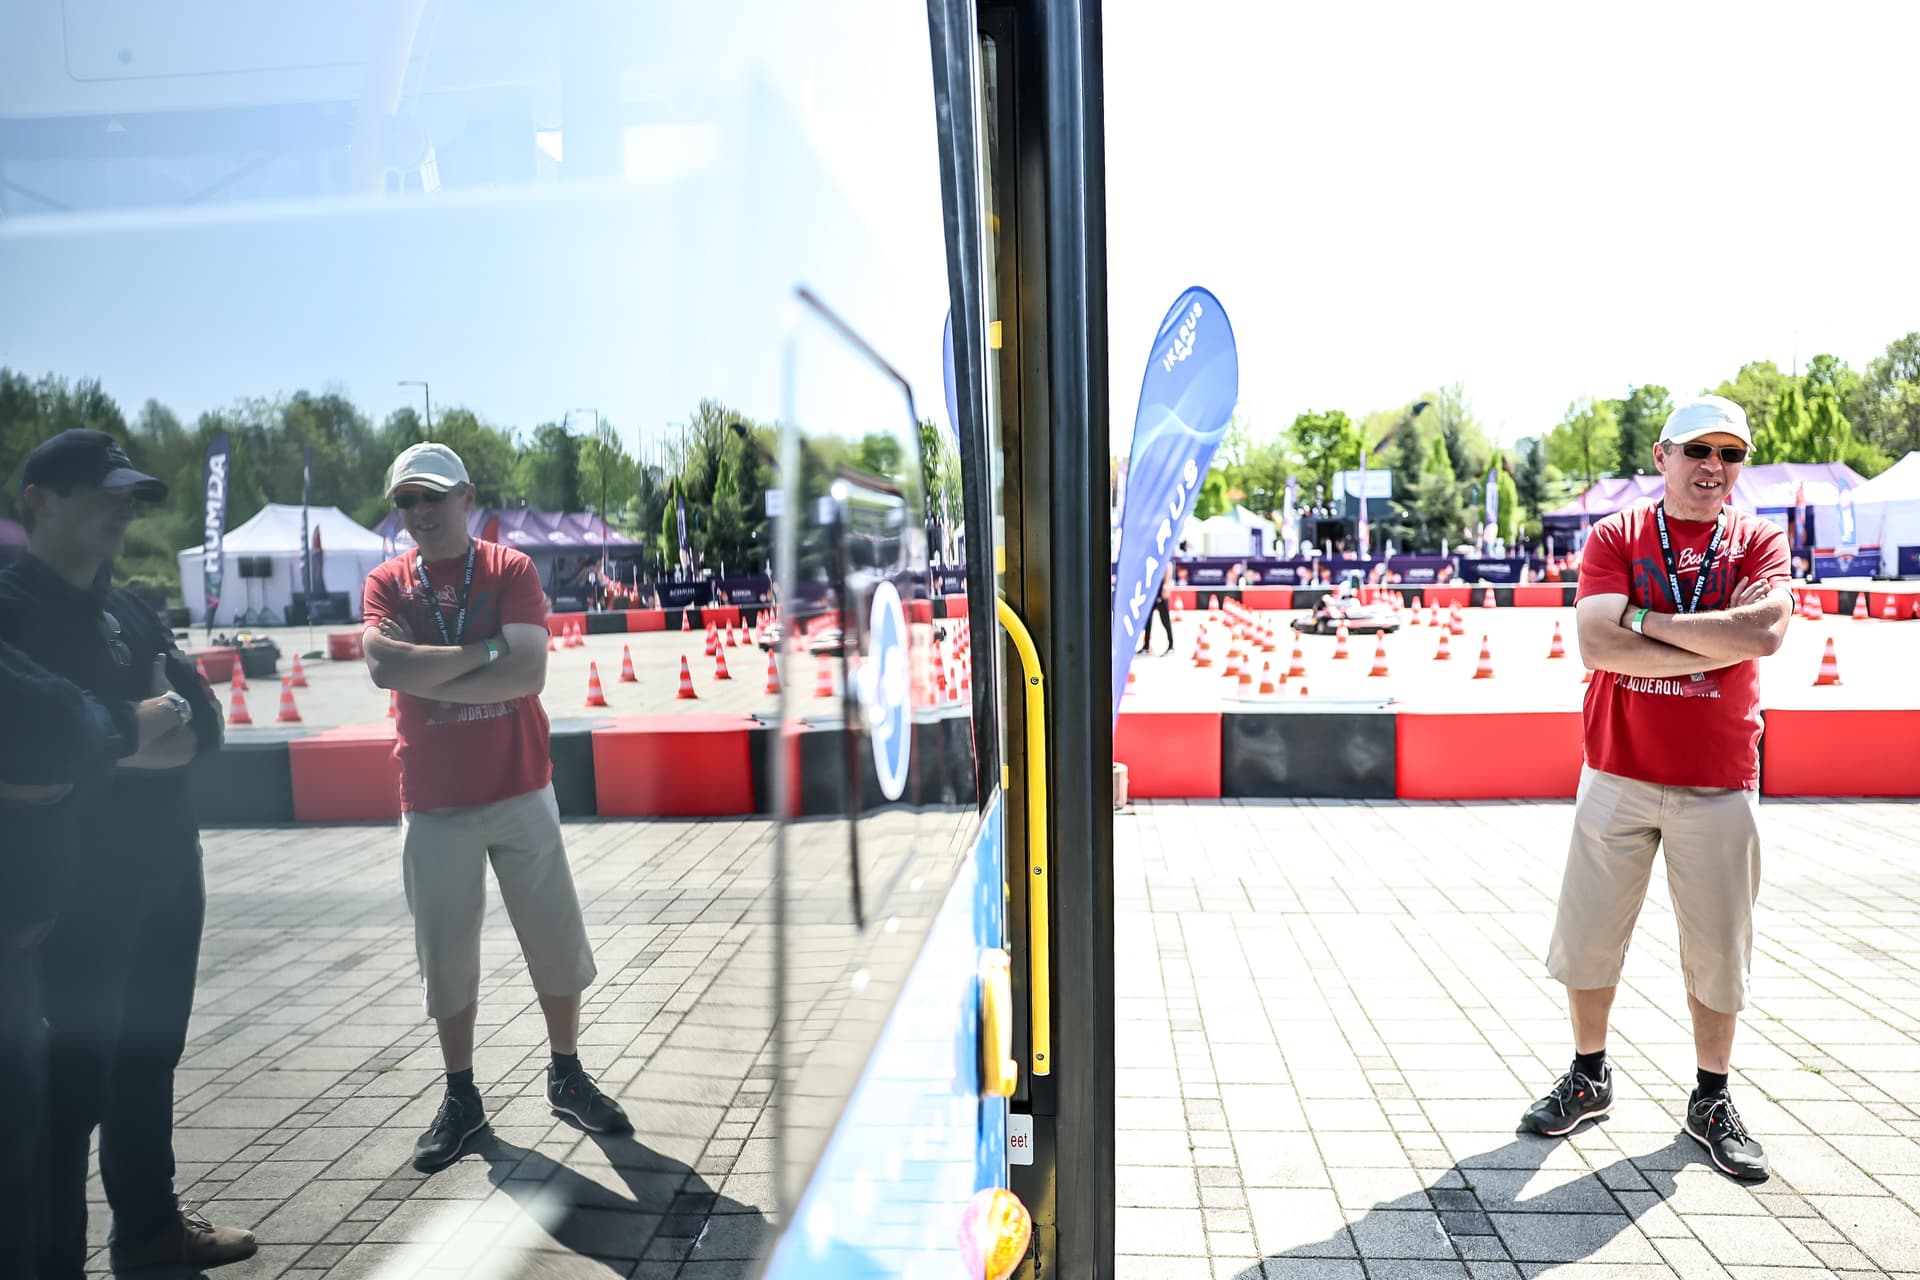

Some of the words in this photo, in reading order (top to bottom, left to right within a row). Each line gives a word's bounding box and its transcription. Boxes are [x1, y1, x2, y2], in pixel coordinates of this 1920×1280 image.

[1162, 301, 1203, 372] IKARUS
[204, 453, 227, 573] HUMDA
[1122, 458, 1199, 636] IKARUS
[1694, 575, 1706, 597] RALLY
